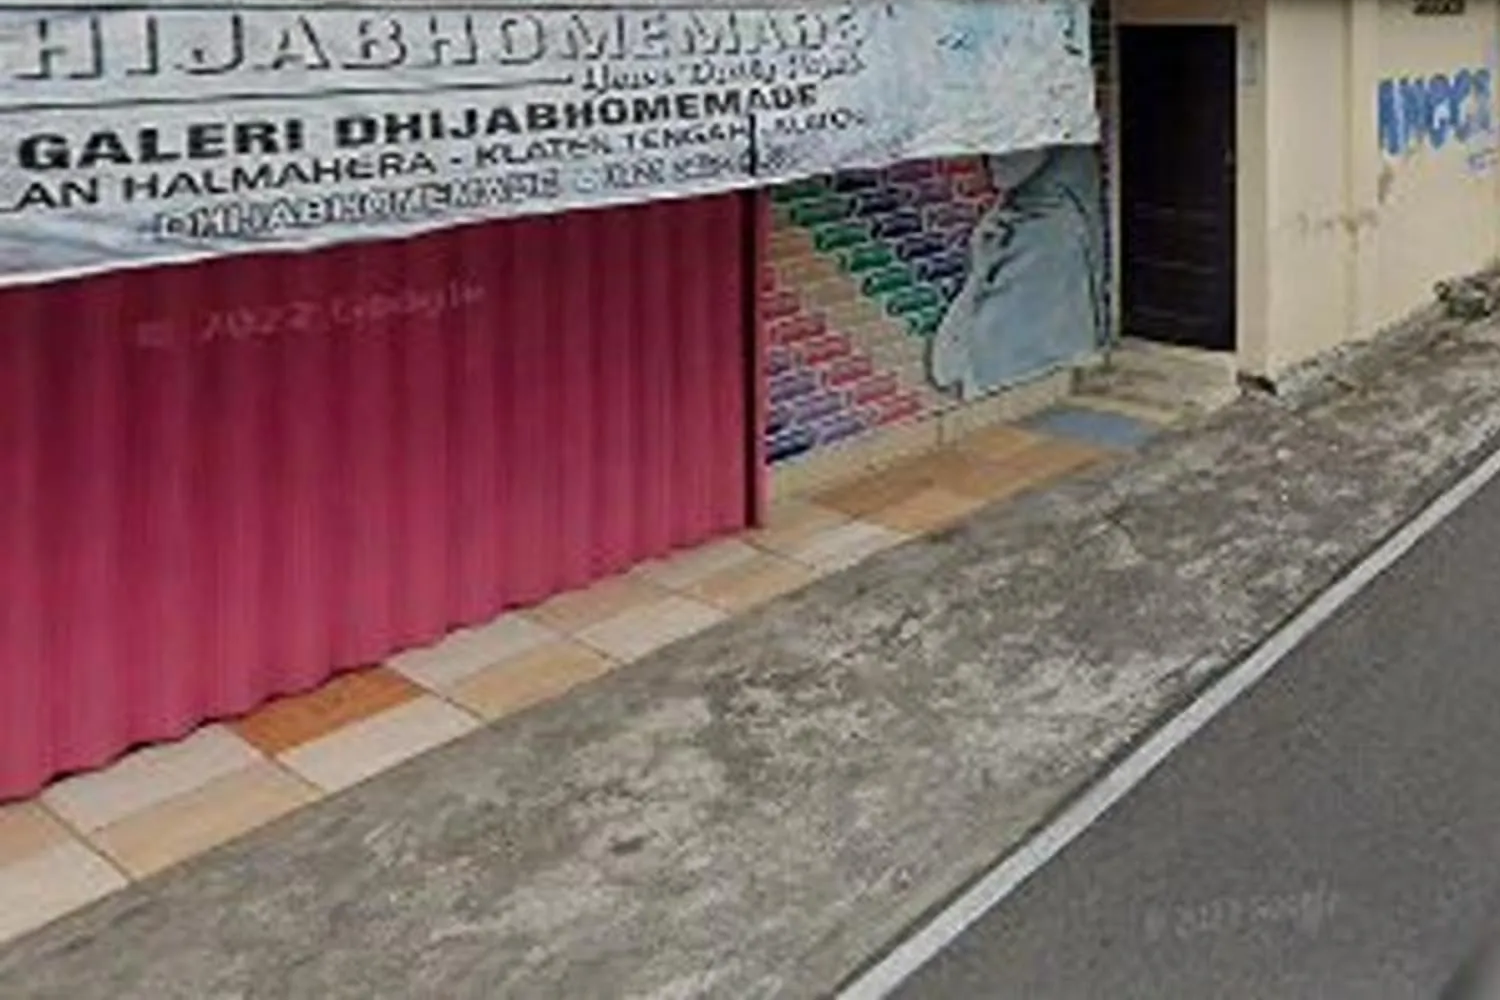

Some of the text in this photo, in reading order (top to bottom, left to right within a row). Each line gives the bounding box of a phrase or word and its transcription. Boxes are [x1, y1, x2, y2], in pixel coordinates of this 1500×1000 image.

[17, 118, 306, 171] GALERI
[336, 81, 818, 148] DHIJABHOMEMADE
[122, 151, 437, 203] HALMAHERA
